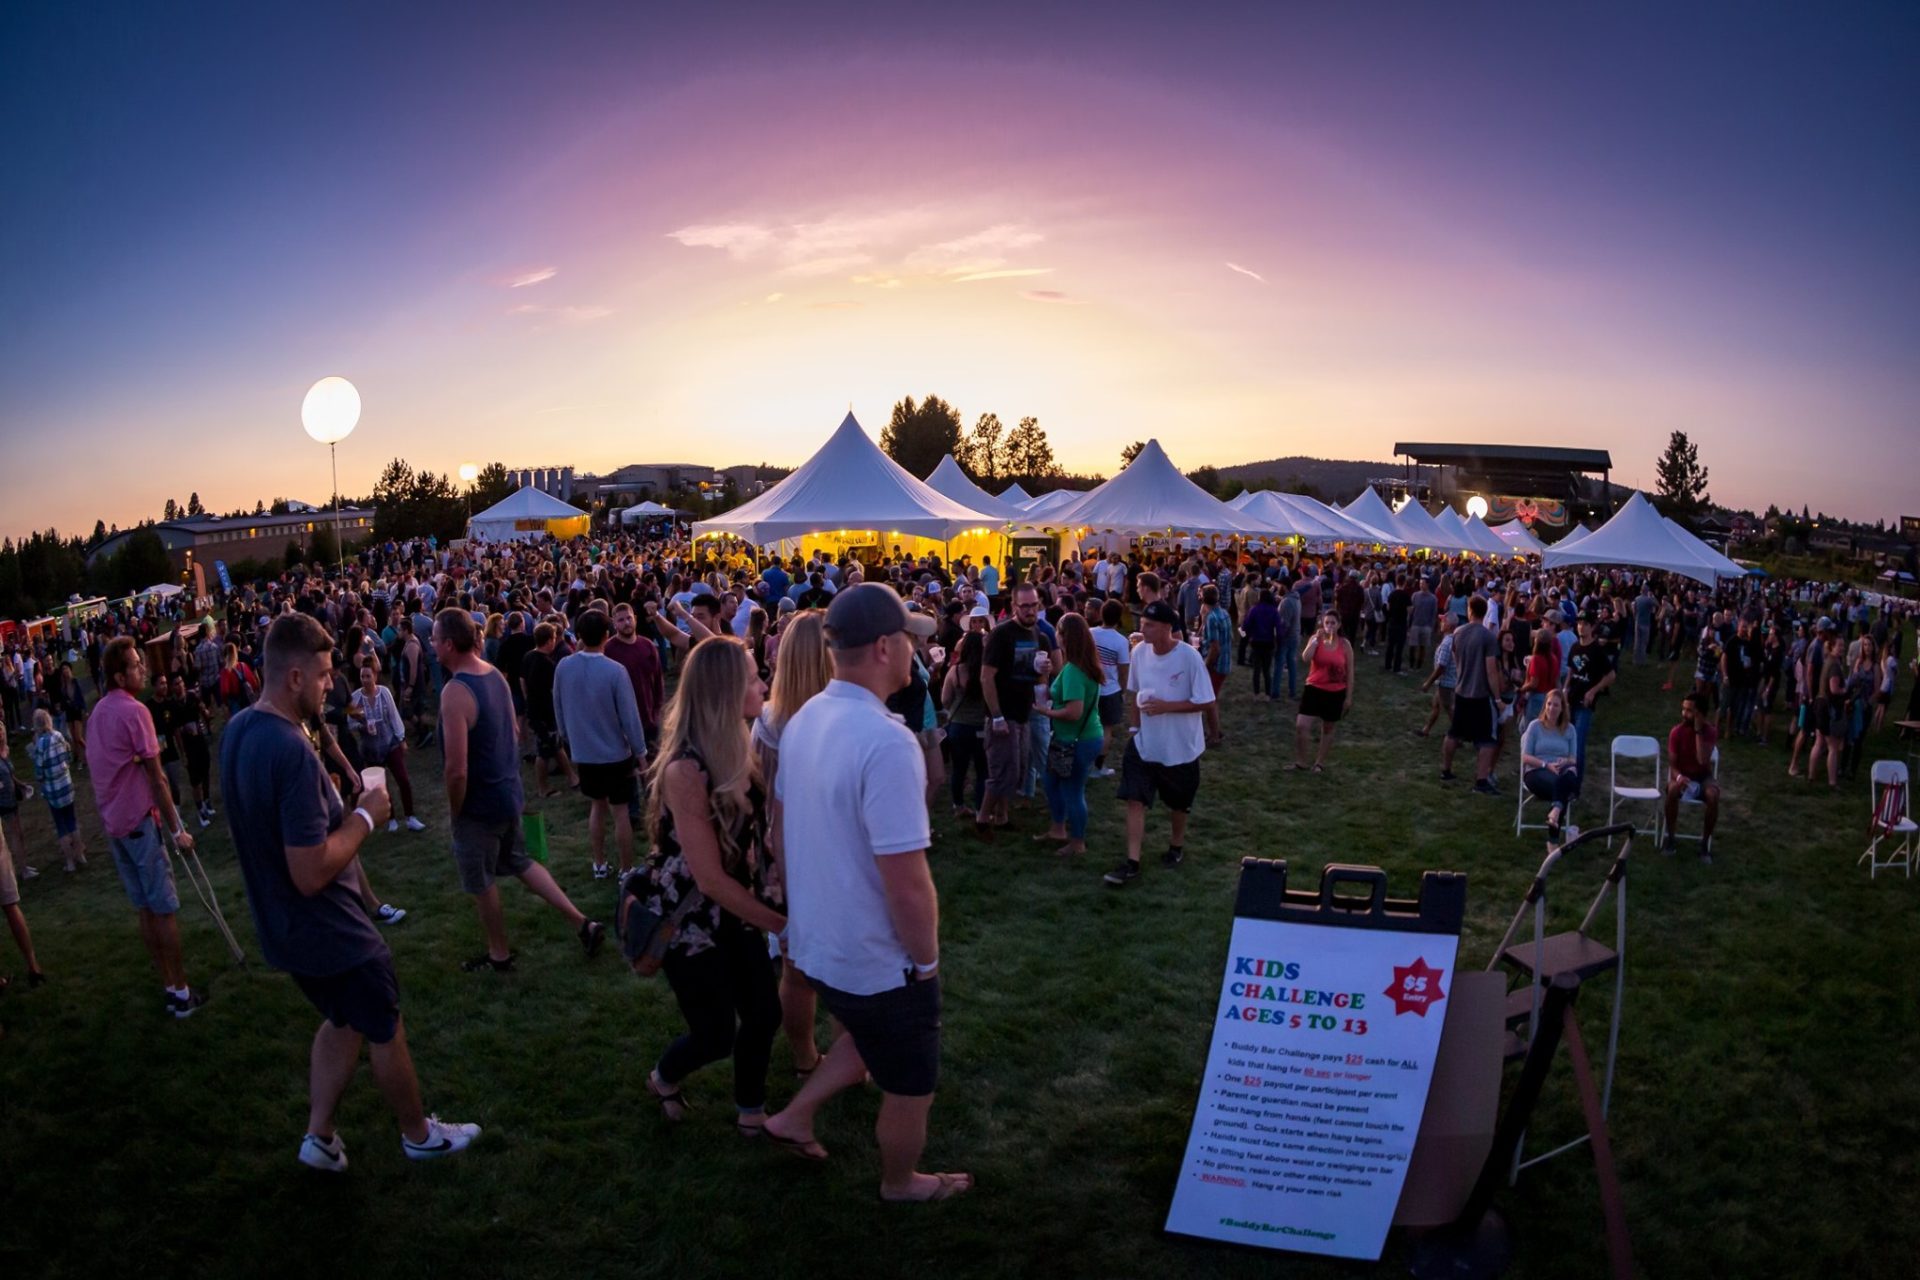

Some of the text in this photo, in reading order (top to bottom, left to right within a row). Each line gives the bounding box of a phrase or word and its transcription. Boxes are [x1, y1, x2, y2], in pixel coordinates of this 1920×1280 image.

[1234, 956, 1300, 980] KIDS
[1404, 974, 1428, 992] $5
[1230, 982, 1366, 1010] CHALLENGE
[1403, 993, 1427, 1003] Entry
[1224, 1005, 1368, 1036] AGES 5 TO 13
[1231, 1042, 1259, 1054] Buddy
[1261, 1046, 1276, 1054] Bar
[1278, 1048, 1320, 1060] Challenge
[1322, 1054, 1343, 1062] pays
[1345, 1054, 1364, 1066] $25
[1364, 1057, 1386, 1065] cash
[1400, 1060, 1418, 1070] ALL
[1228, 1058, 1244, 1067] kids
[1248, 1061, 1264, 1069] that
[1266, 1064, 1288, 1074] hang
[1344, 1072, 1372, 1082] longer
[1224, 1074, 1242, 1082] One
[1244, 1075, 1262, 1087] $25
[1264, 1080, 1294, 1089] payout
[1311, 1086, 1356, 1096] participant
[1220, 1089, 1248, 1099] Parent
[1261, 1096, 1298, 1106] guardian
[1301, 1100, 1322, 1109] must
[1324, 1102, 1334, 1110] be
[1336, 1104, 1369, 1114] present
[1217, 1104, 1404, 1132] Must hang from hands (feet cannot touch the
[1210, 1131, 1236, 1142] Hands
[1239, 1136, 1260, 1145] must
[1262, 1138, 1280, 1148] face
[1307, 1145, 1344, 1154] direction
[1254, 1123, 1278, 1132] Clock
[1280, 1127, 1304, 1137] starts
[1306, 1130, 1328, 1138] when
[1331, 1132, 1352, 1142] hang
[1206, 1146, 1218, 1154] No
[1221, 1148, 1244, 1159] lifting
[1246, 1152, 1263, 1160] feet
[1265, 1154, 1290, 1164] above
[1292, 1158, 1314, 1166] waist
[1328, 1162, 1365, 1173] swinging
[1203, 1159, 1215, 1168] No
[1250, 1167, 1270, 1175] resin
[1283, 1171, 1306, 1179] other
[1307, 1174, 1333, 1184] sticky
[1334, 1176, 1372, 1186] materials
[1252, 1181, 1274, 1191] Hang
[1220, 1217, 1336, 1240] #BuddyBarChallenge
